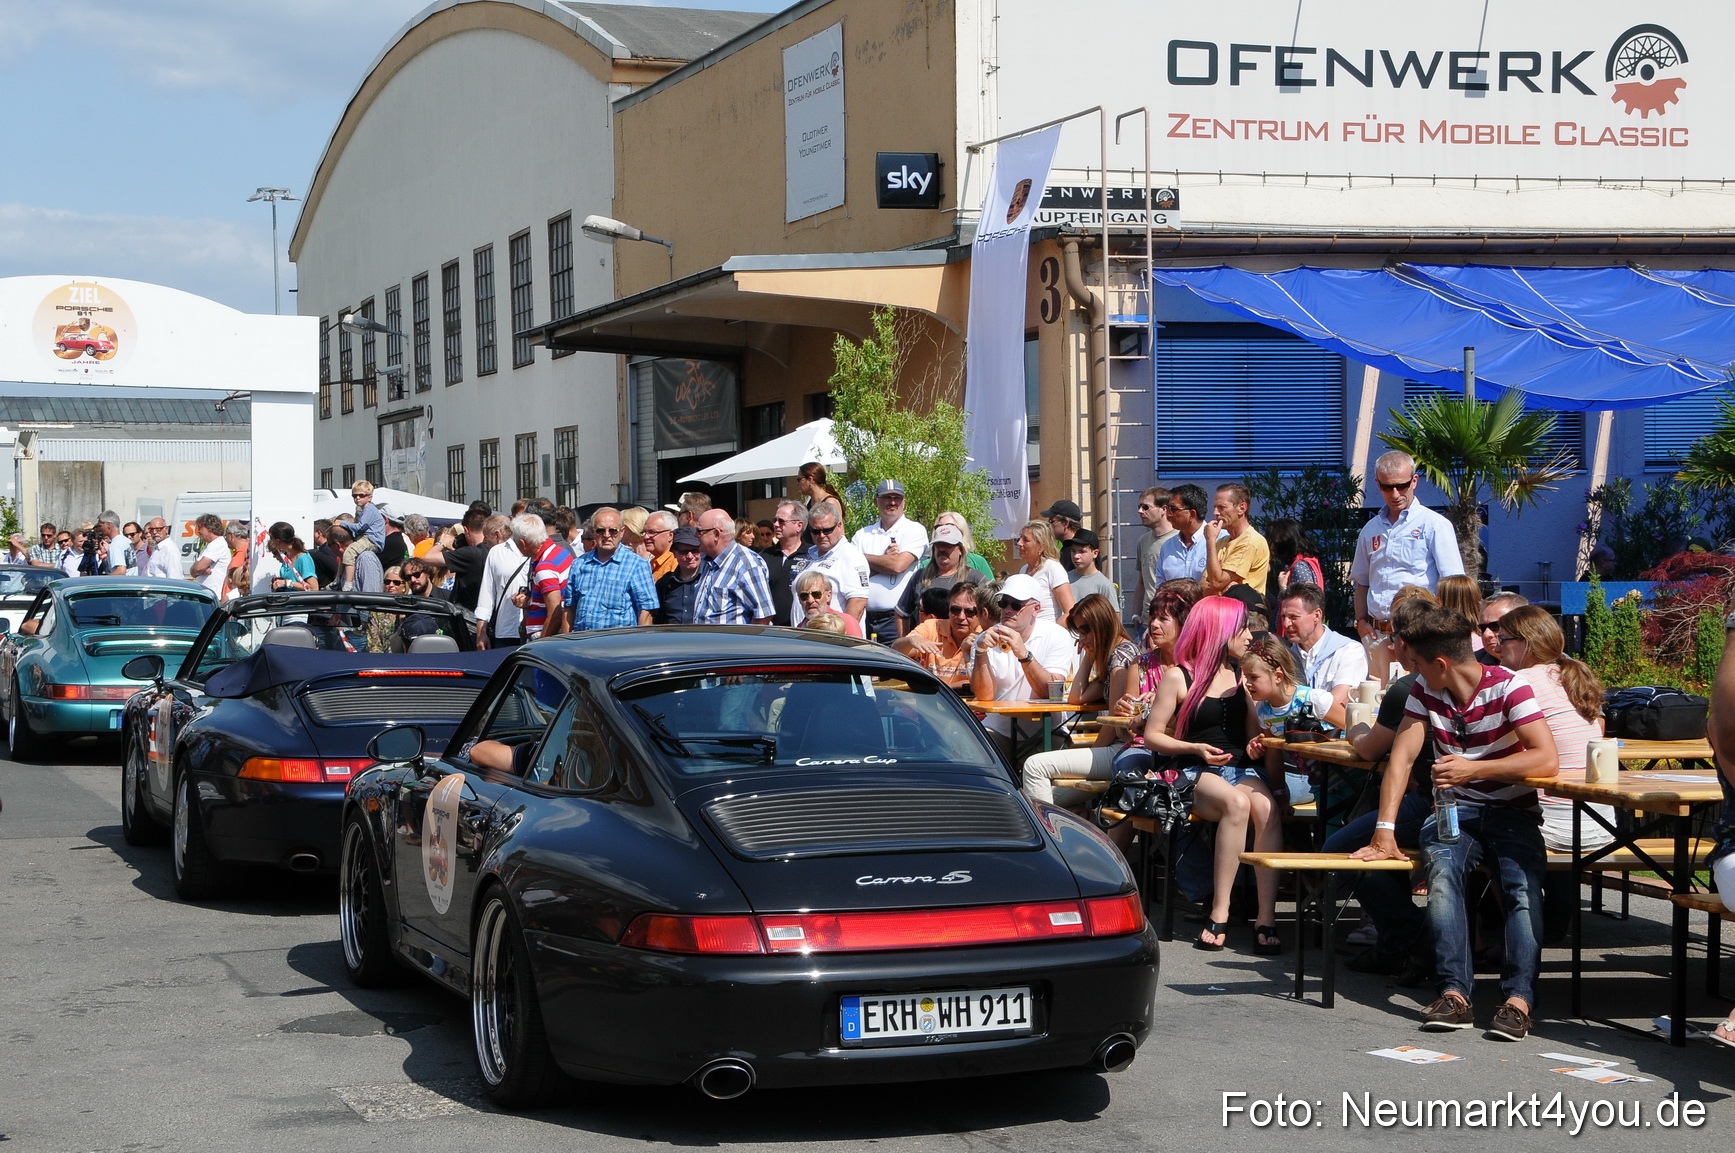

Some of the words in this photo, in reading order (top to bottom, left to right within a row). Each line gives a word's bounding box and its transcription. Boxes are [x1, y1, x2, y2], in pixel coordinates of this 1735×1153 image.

[1167, 39, 1597, 95] OFENWERK
[787, 64, 831, 93] OFENWERK
[887, 165, 933, 196] sky
[1043, 187, 1152, 199] ENWERK
[1033, 212, 1168, 225] UPTEINGANG
[977, 224, 1029, 242] PORSCHE
[69, 287, 102, 303] ZIEL
[1040, 256, 1062, 324] 3
[427, 405, 433, 439] 2
[795, 757, 861, 767] Carrera
[863, 755, 898, 765] Cup
[855, 875, 935, 885] Carrera
[863, 999, 918, 1034] ERH
[937, 995, 972, 1029] WH
[979, 992, 1028, 1026] 911
[848, 1022, 856, 1032] D
